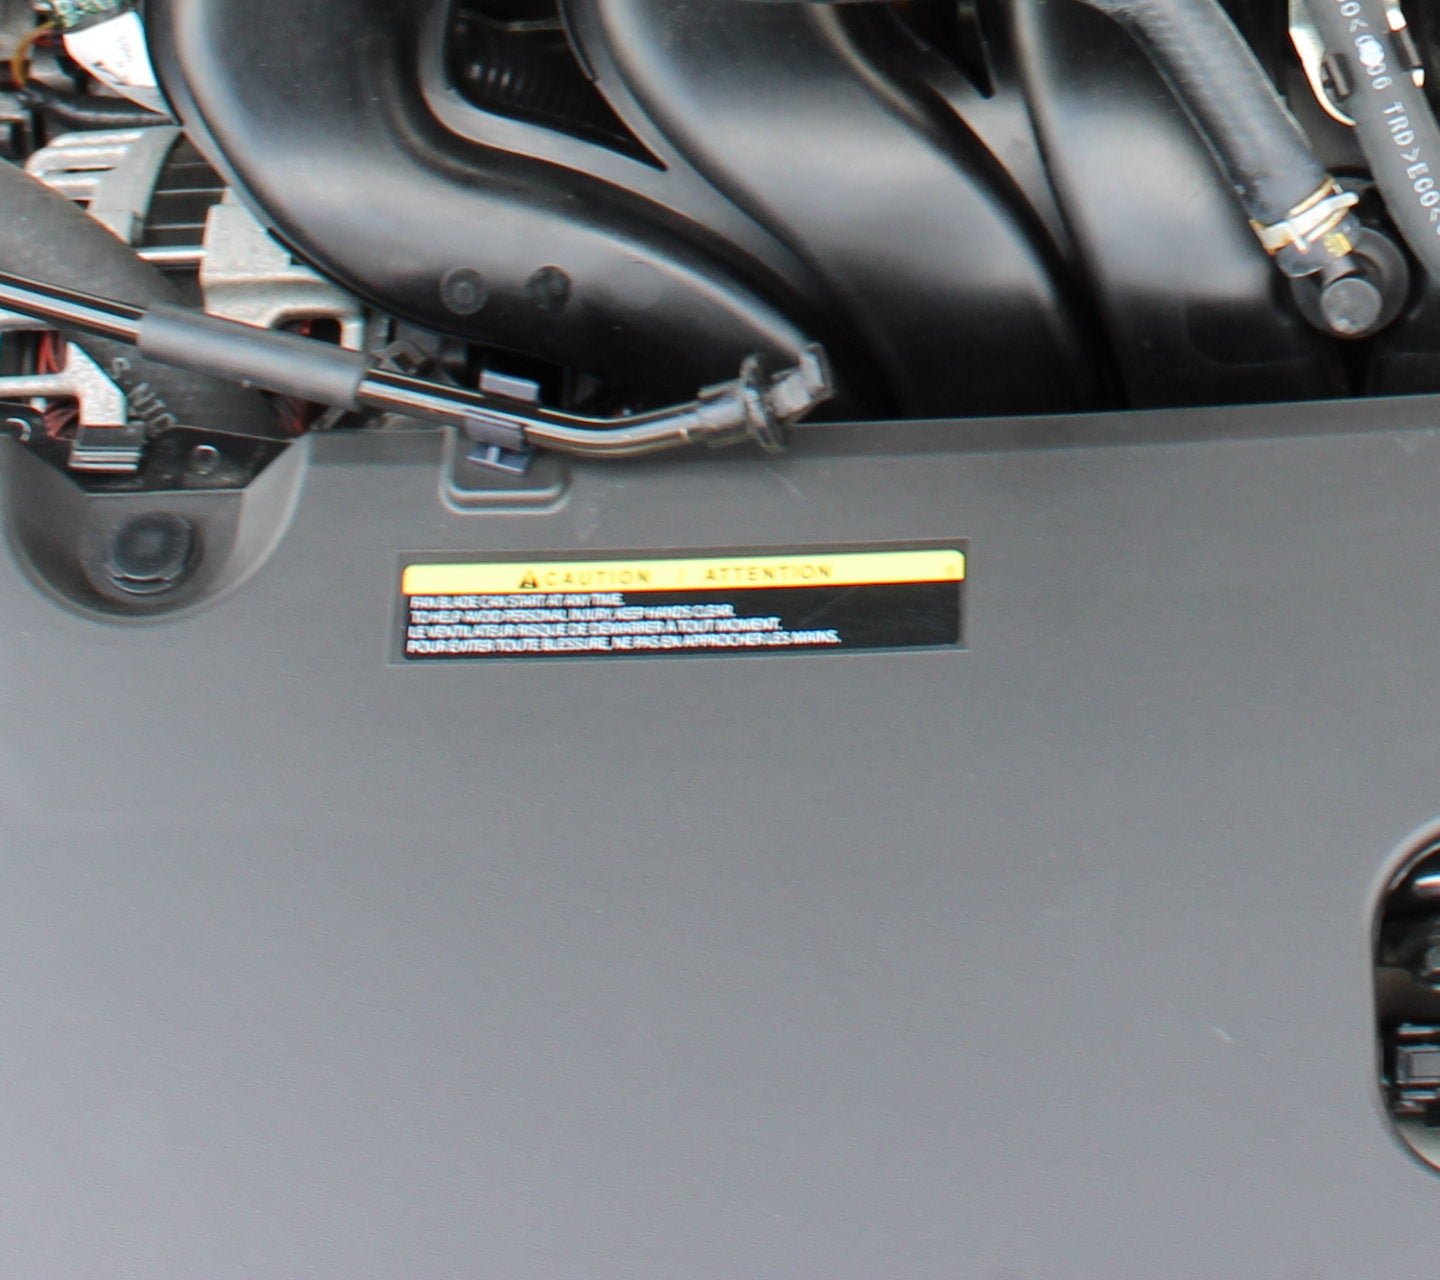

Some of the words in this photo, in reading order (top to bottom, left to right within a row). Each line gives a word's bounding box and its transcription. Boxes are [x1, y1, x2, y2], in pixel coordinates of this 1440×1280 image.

[544, 569, 650, 586] CAUTION
[704, 564, 832, 582] ATTENTION
[509, 594, 546, 607] START
[591, 593, 625, 605] TIME.
[503, 607, 567, 622] PERSONAL
[408, 625, 426, 638] LE
[427, 623, 515, 638] VENTILATEUR
[567, 621, 587, 635] DE
[678, 618, 714, 633] TOUT
[497, 637, 539, 651] TOUTE
[611, 635, 632, 649] NE
[762, 631, 791, 645] LES
